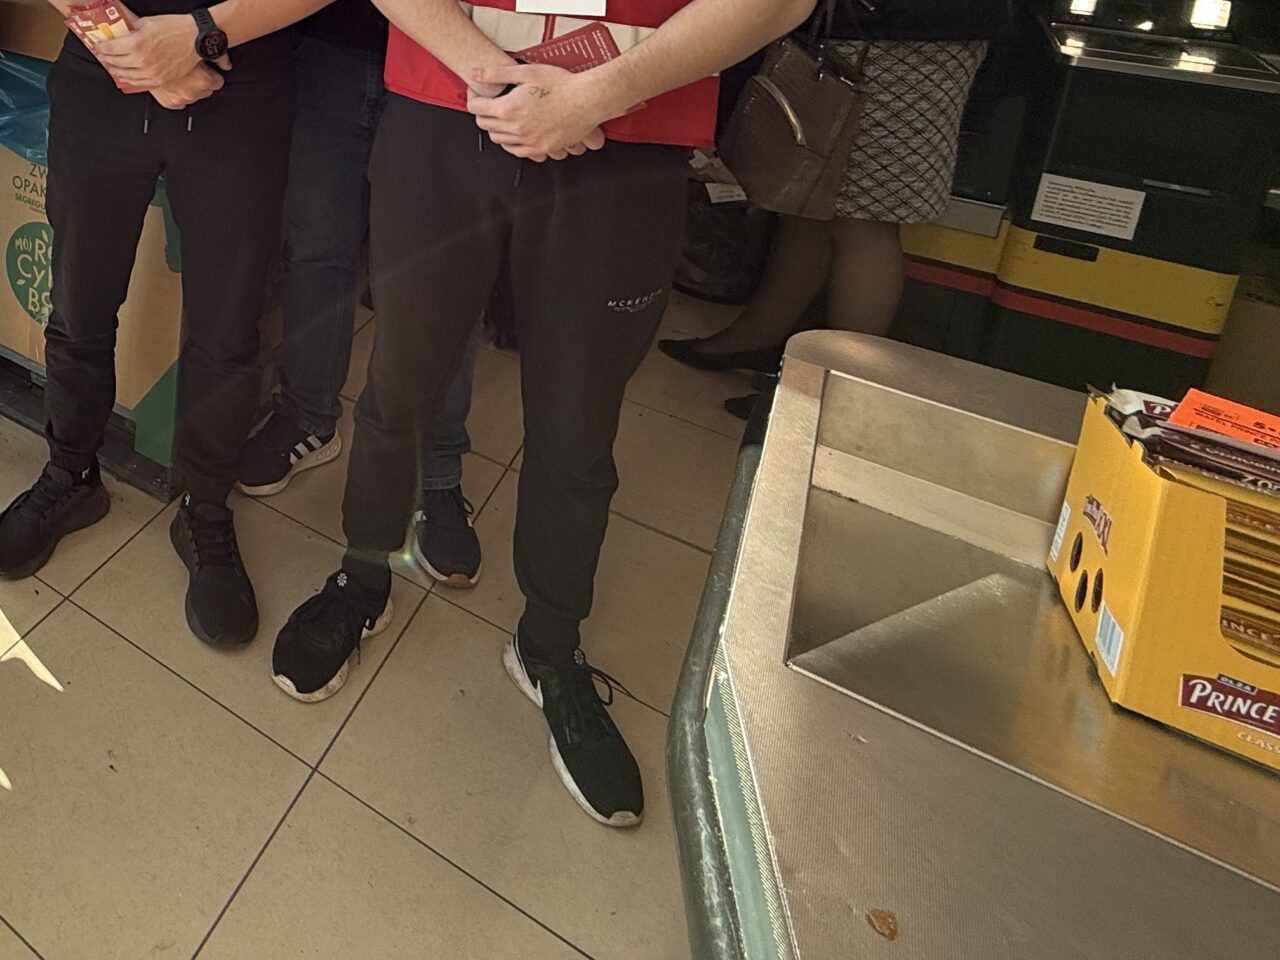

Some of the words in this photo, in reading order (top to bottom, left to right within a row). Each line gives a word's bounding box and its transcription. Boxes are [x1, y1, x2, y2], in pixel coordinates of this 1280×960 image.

[1221, 618, 1272, 642] INCE
[1188, 679, 1280, 724] PRINCE
[1237, 730, 1280, 754] CLASS
